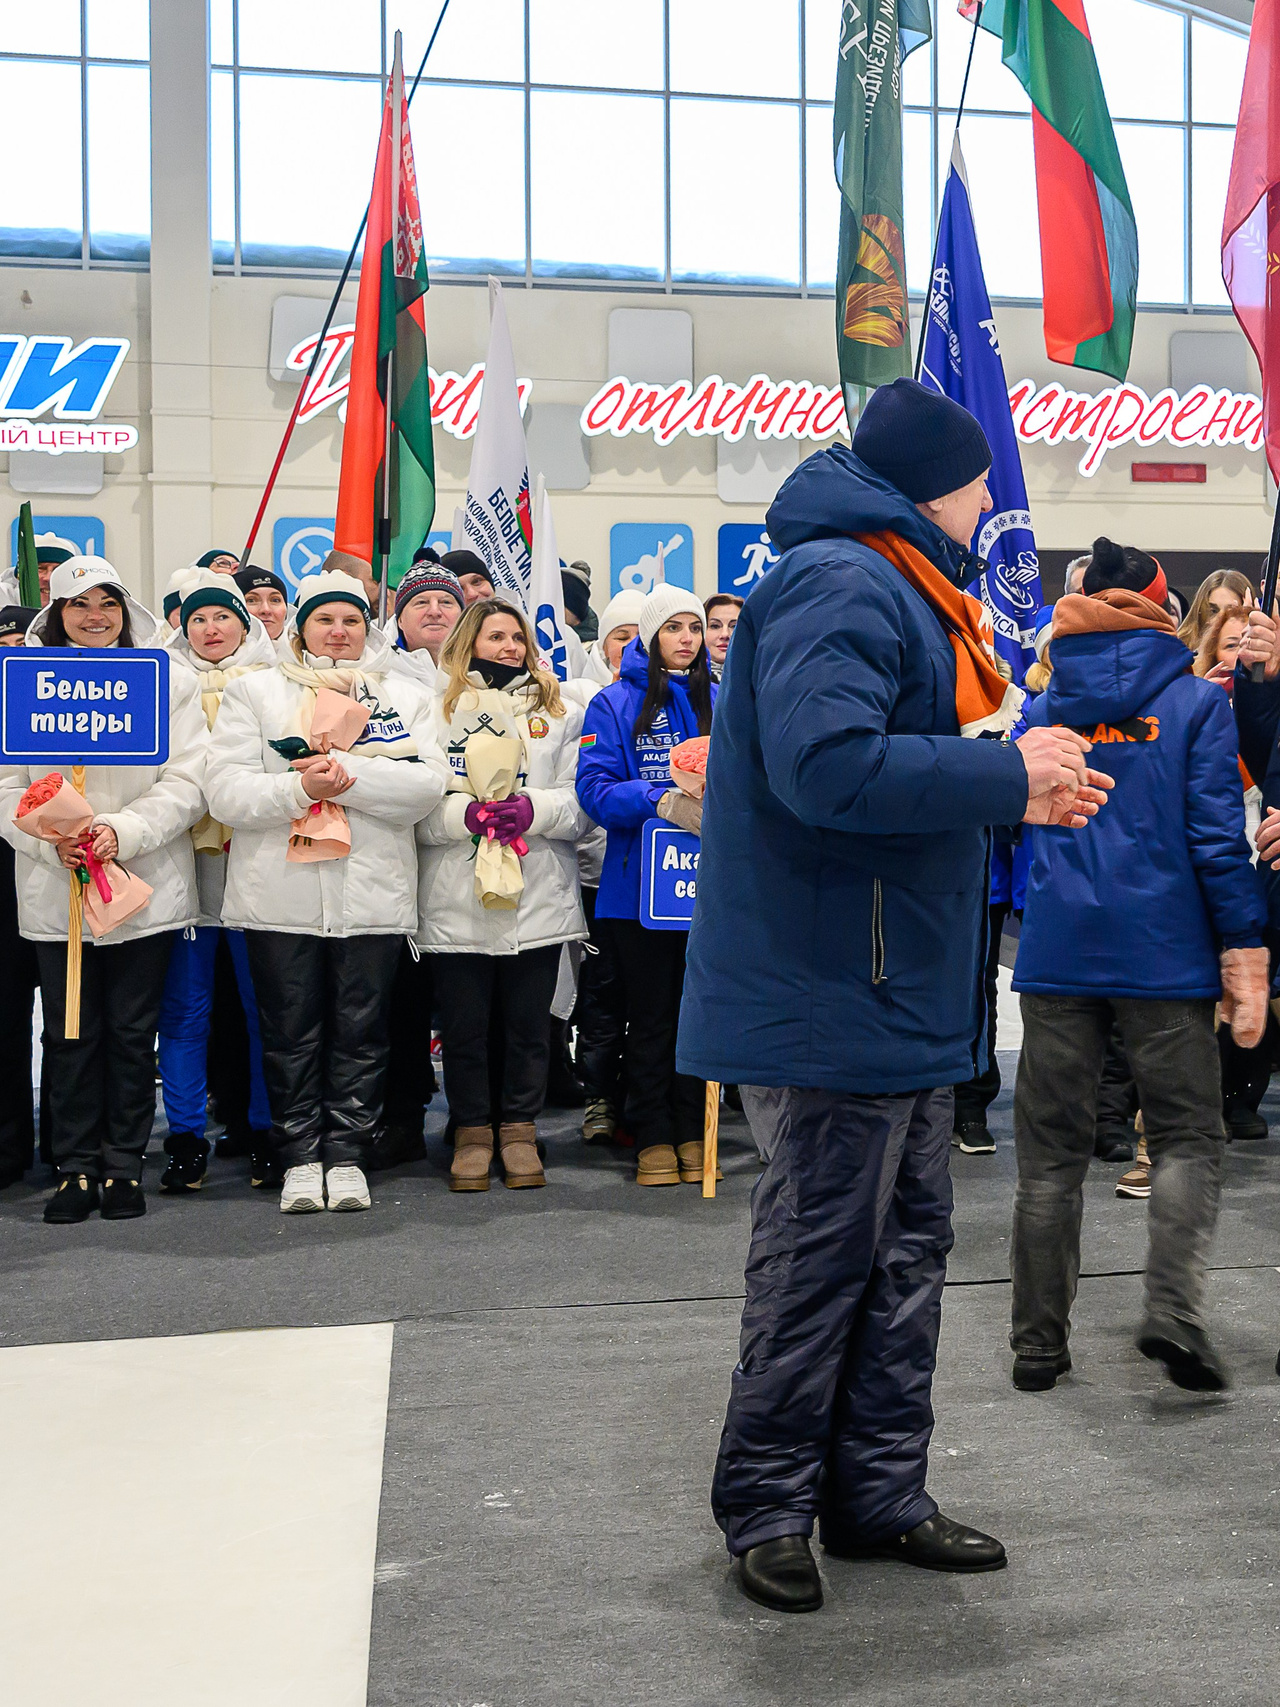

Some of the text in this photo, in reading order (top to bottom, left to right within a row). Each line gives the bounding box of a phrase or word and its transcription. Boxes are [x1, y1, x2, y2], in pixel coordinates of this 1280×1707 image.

[588, 379, 850, 440] отлично
[38, 430, 130, 448] ЦЕНТР
[487, 486, 523, 554] БЕЛЫЕ
[36, 671, 129, 701] Белые
[31, 710, 133, 742] тигры
[674, 879, 697, 899] се
